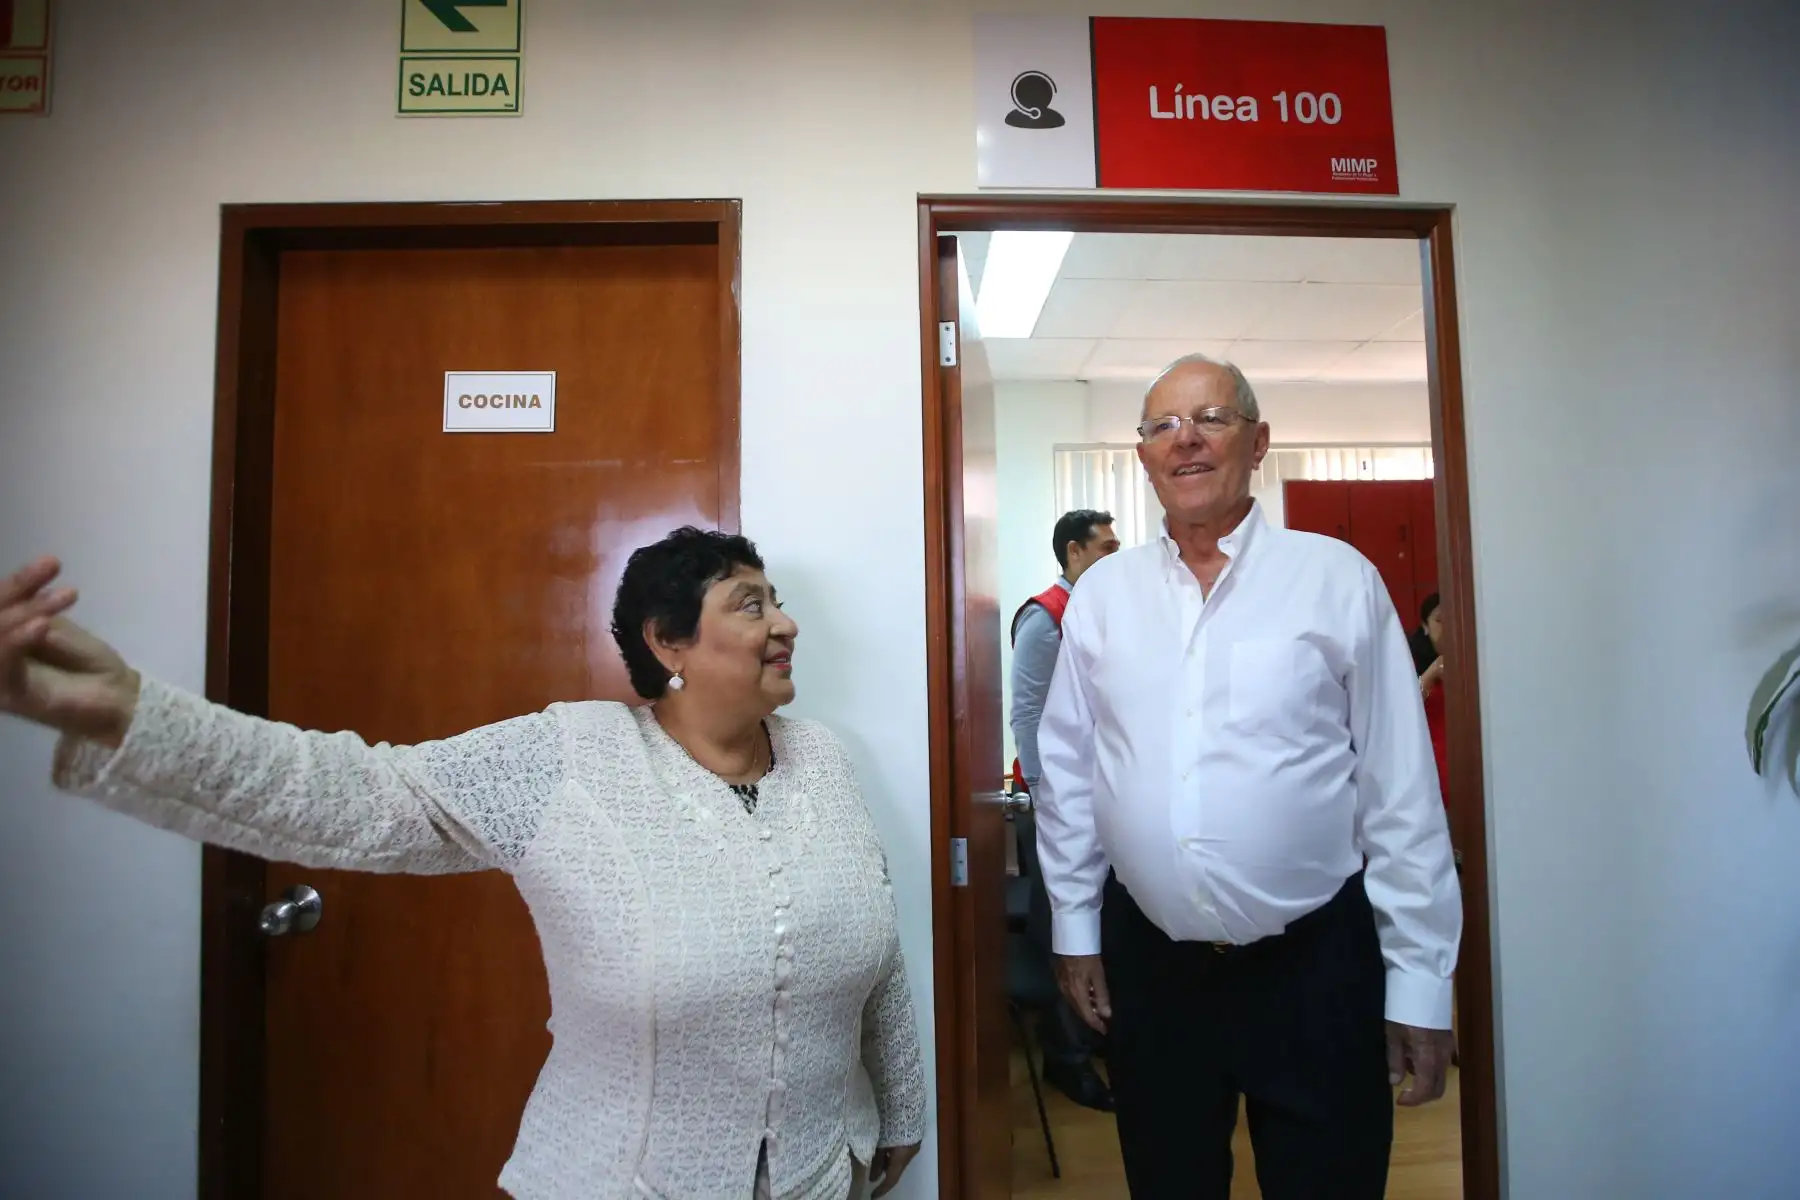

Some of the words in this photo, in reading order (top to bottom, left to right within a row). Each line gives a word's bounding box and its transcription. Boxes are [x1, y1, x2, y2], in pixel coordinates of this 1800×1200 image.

[409, 73, 510, 96] SALIDA
[1149, 83, 1258, 121] Línea
[1272, 91, 1342, 124] 100
[1331, 157, 1378, 173] MIMP
[458, 394, 542, 409] COCINA
